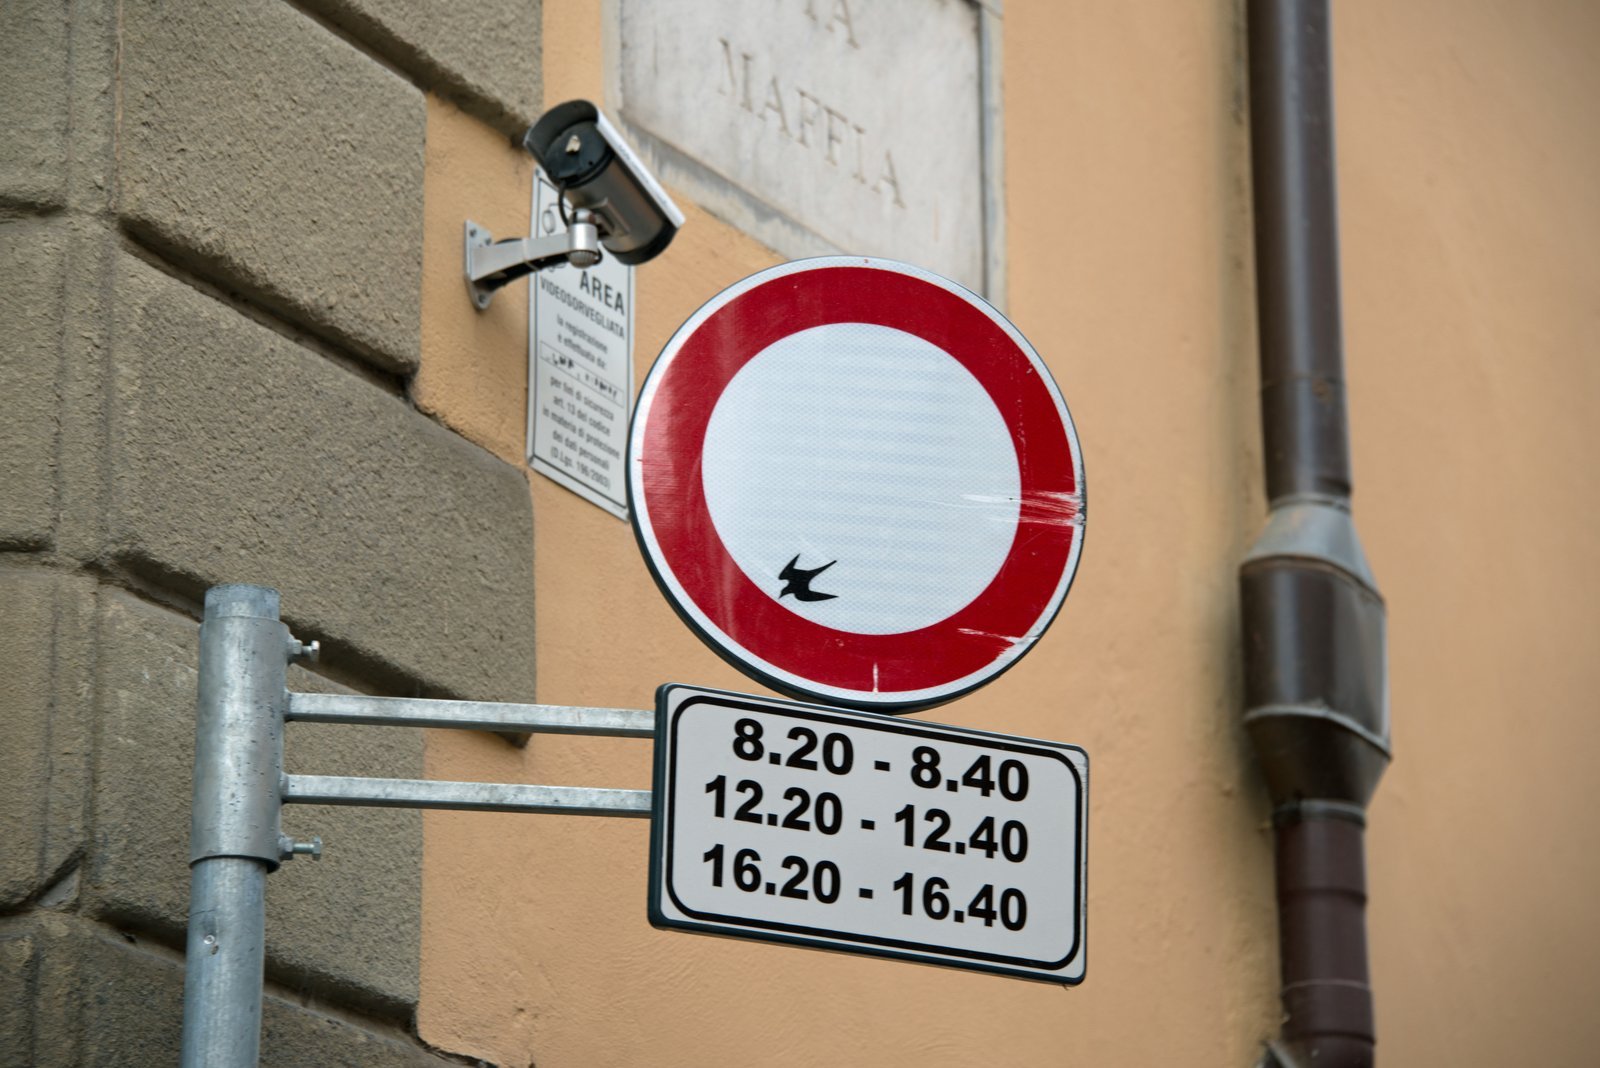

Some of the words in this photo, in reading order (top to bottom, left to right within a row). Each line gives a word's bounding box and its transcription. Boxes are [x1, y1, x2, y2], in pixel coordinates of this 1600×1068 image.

[718, 37, 907, 210] MAFFIA
[540, 276, 625, 340] VIDEOSORVEGLIATA
[580, 270, 625, 316] AREA
[565, 321, 608, 354] registrazione
[732, 717, 855, 776] 8.20
[910, 745, 1030, 802] 8.40
[704, 774, 843, 835] 12.20
[894, 803, 1028, 863] 12.40
[702, 843, 841, 904] 16.20
[892, 871, 1027, 931] 16.40
